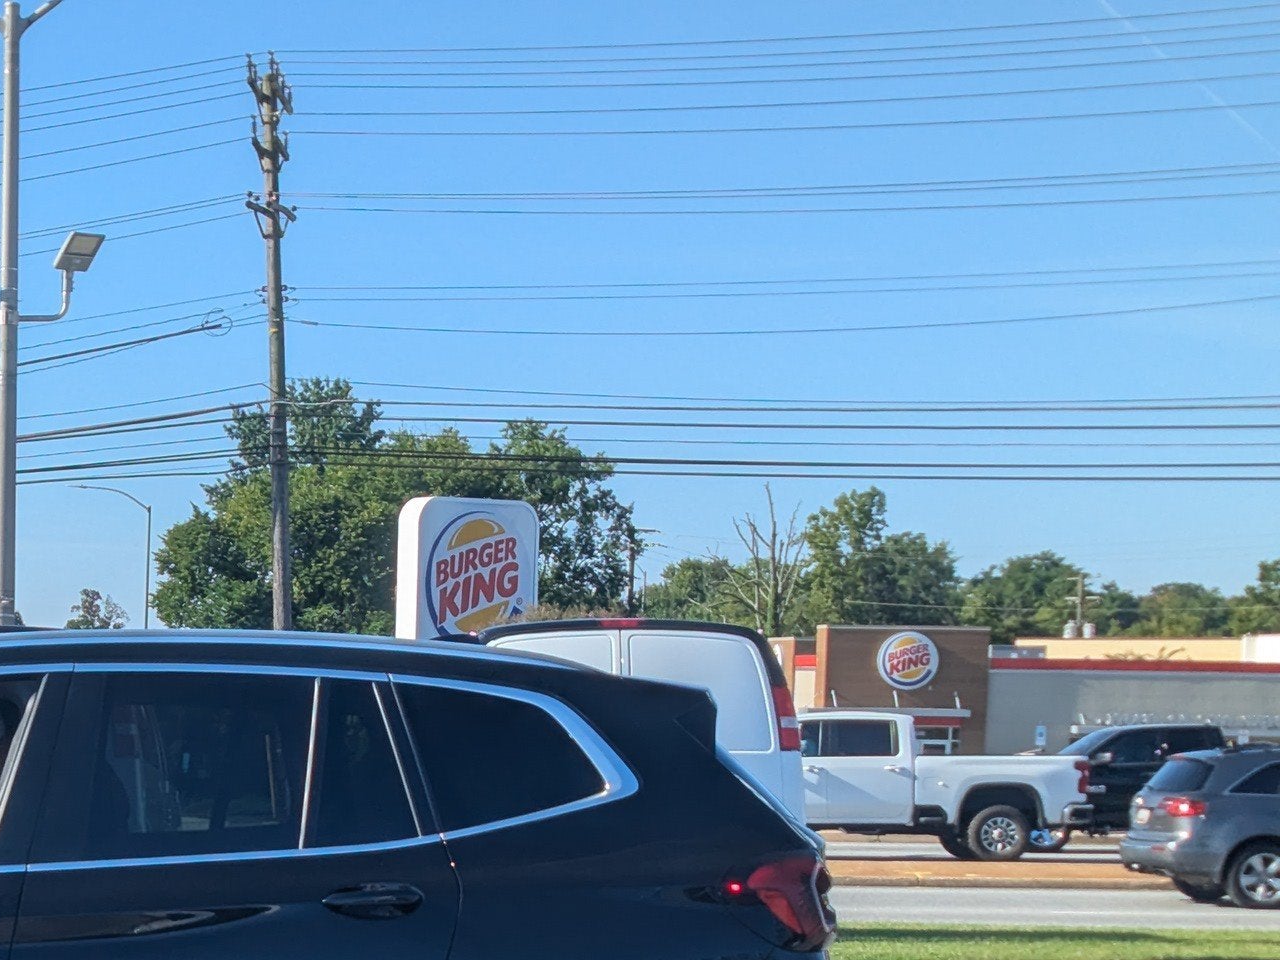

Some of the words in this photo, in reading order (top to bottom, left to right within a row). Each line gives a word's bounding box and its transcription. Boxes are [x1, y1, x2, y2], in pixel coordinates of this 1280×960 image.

[436, 537, 517, 588] BURGER
[438, 562, 519, 625] KING
[888, 643, 929, 662] BURGER
[889, 652, 931, 676] KING
